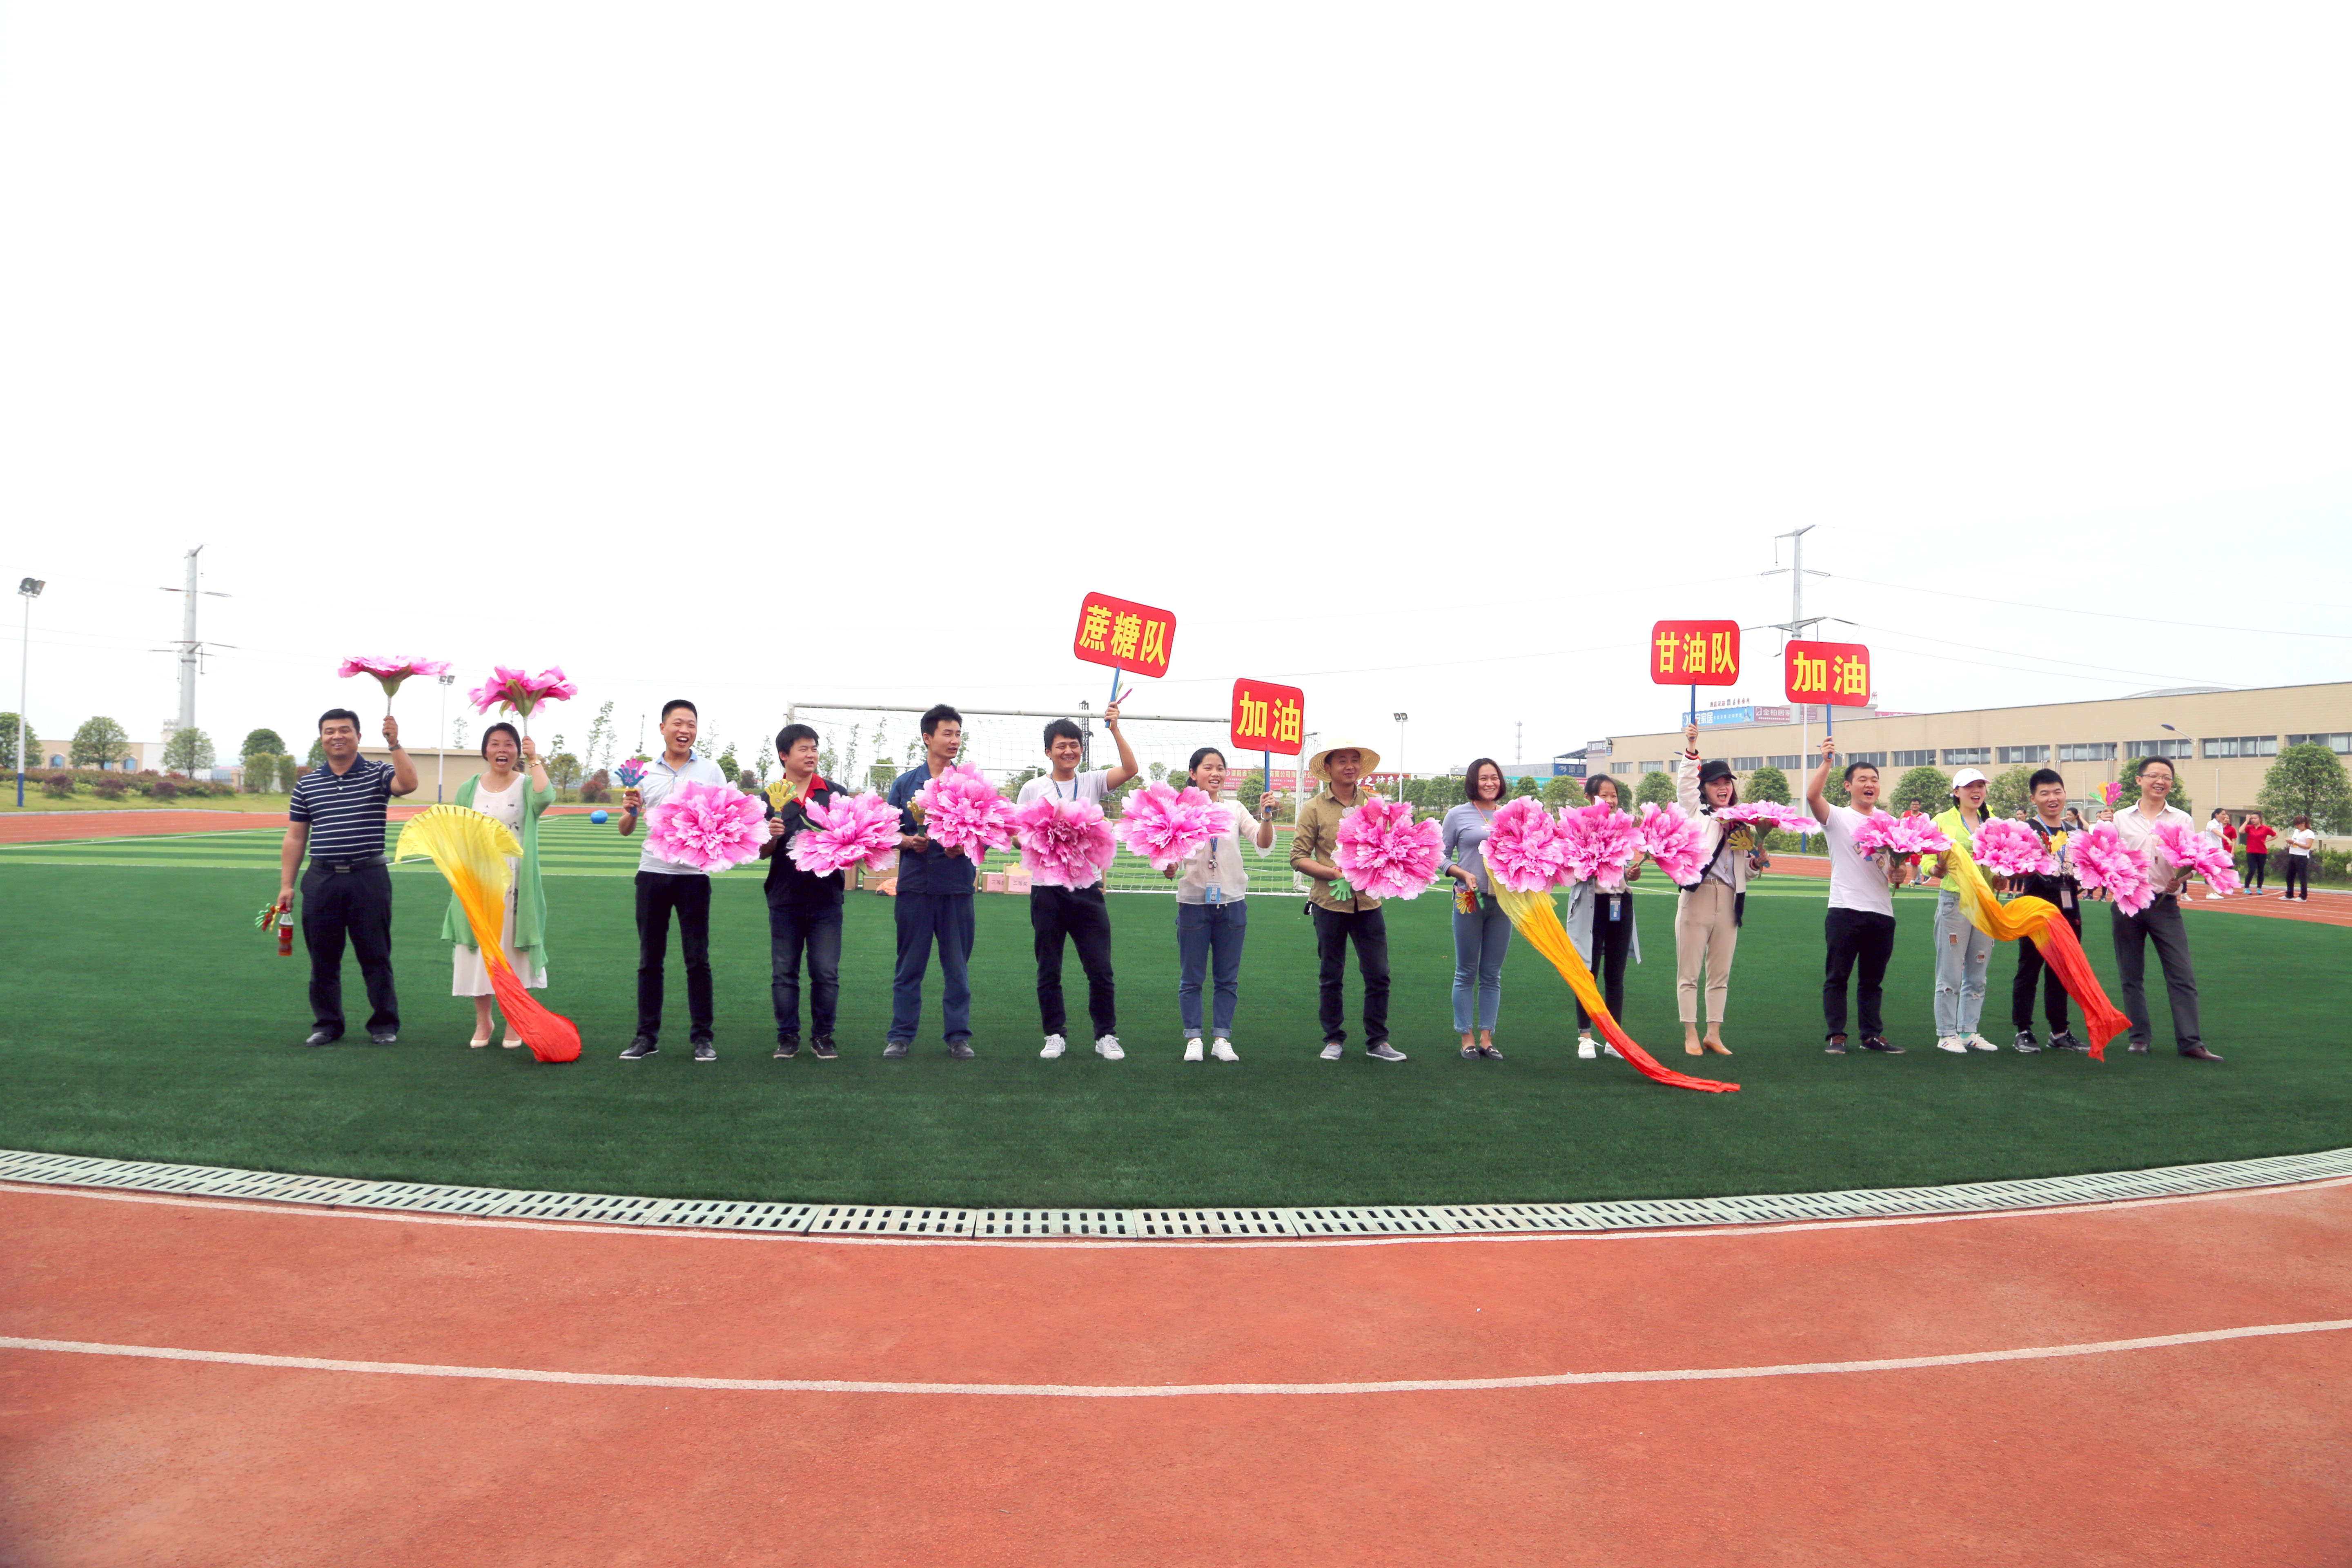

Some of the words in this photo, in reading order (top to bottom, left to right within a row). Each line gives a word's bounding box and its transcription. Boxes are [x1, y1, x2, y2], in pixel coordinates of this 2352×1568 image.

[1078, 604, 1166, 666] 蔗糖队
[1655, 631, 1736, 674] 甘油队
[1791, 651, 1866, 696] 加油
[1236, 691, 1301, 744] 加油
